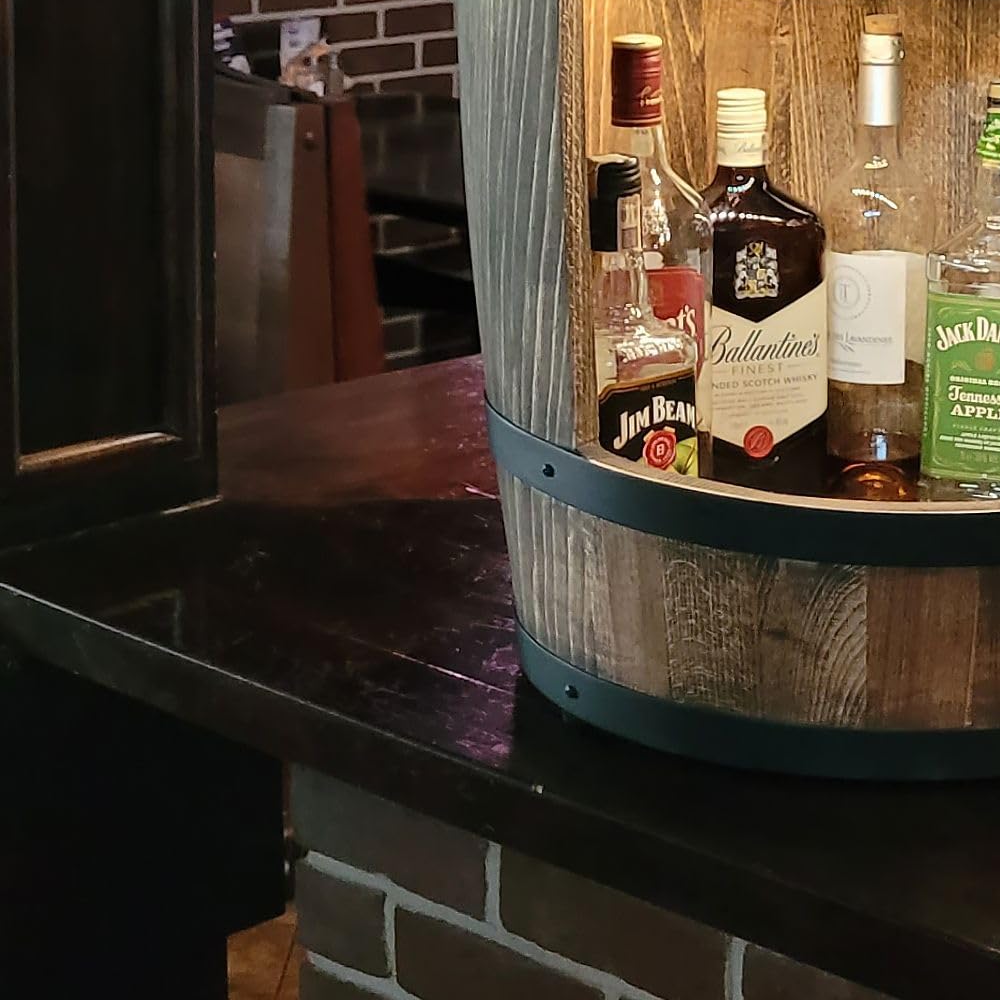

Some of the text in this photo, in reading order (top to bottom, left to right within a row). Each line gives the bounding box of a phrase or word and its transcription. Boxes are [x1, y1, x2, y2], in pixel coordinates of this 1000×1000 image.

[712, 325, 819, 365] Ballantine's
[936, 321, 976, 351] JACK
[731, 362, 784, 376] FINEST
[743, 377, 780, 389] SCOTCH
[783, 374, 817, 385] WHISKY
[613, 405, 650, 450] JIM
